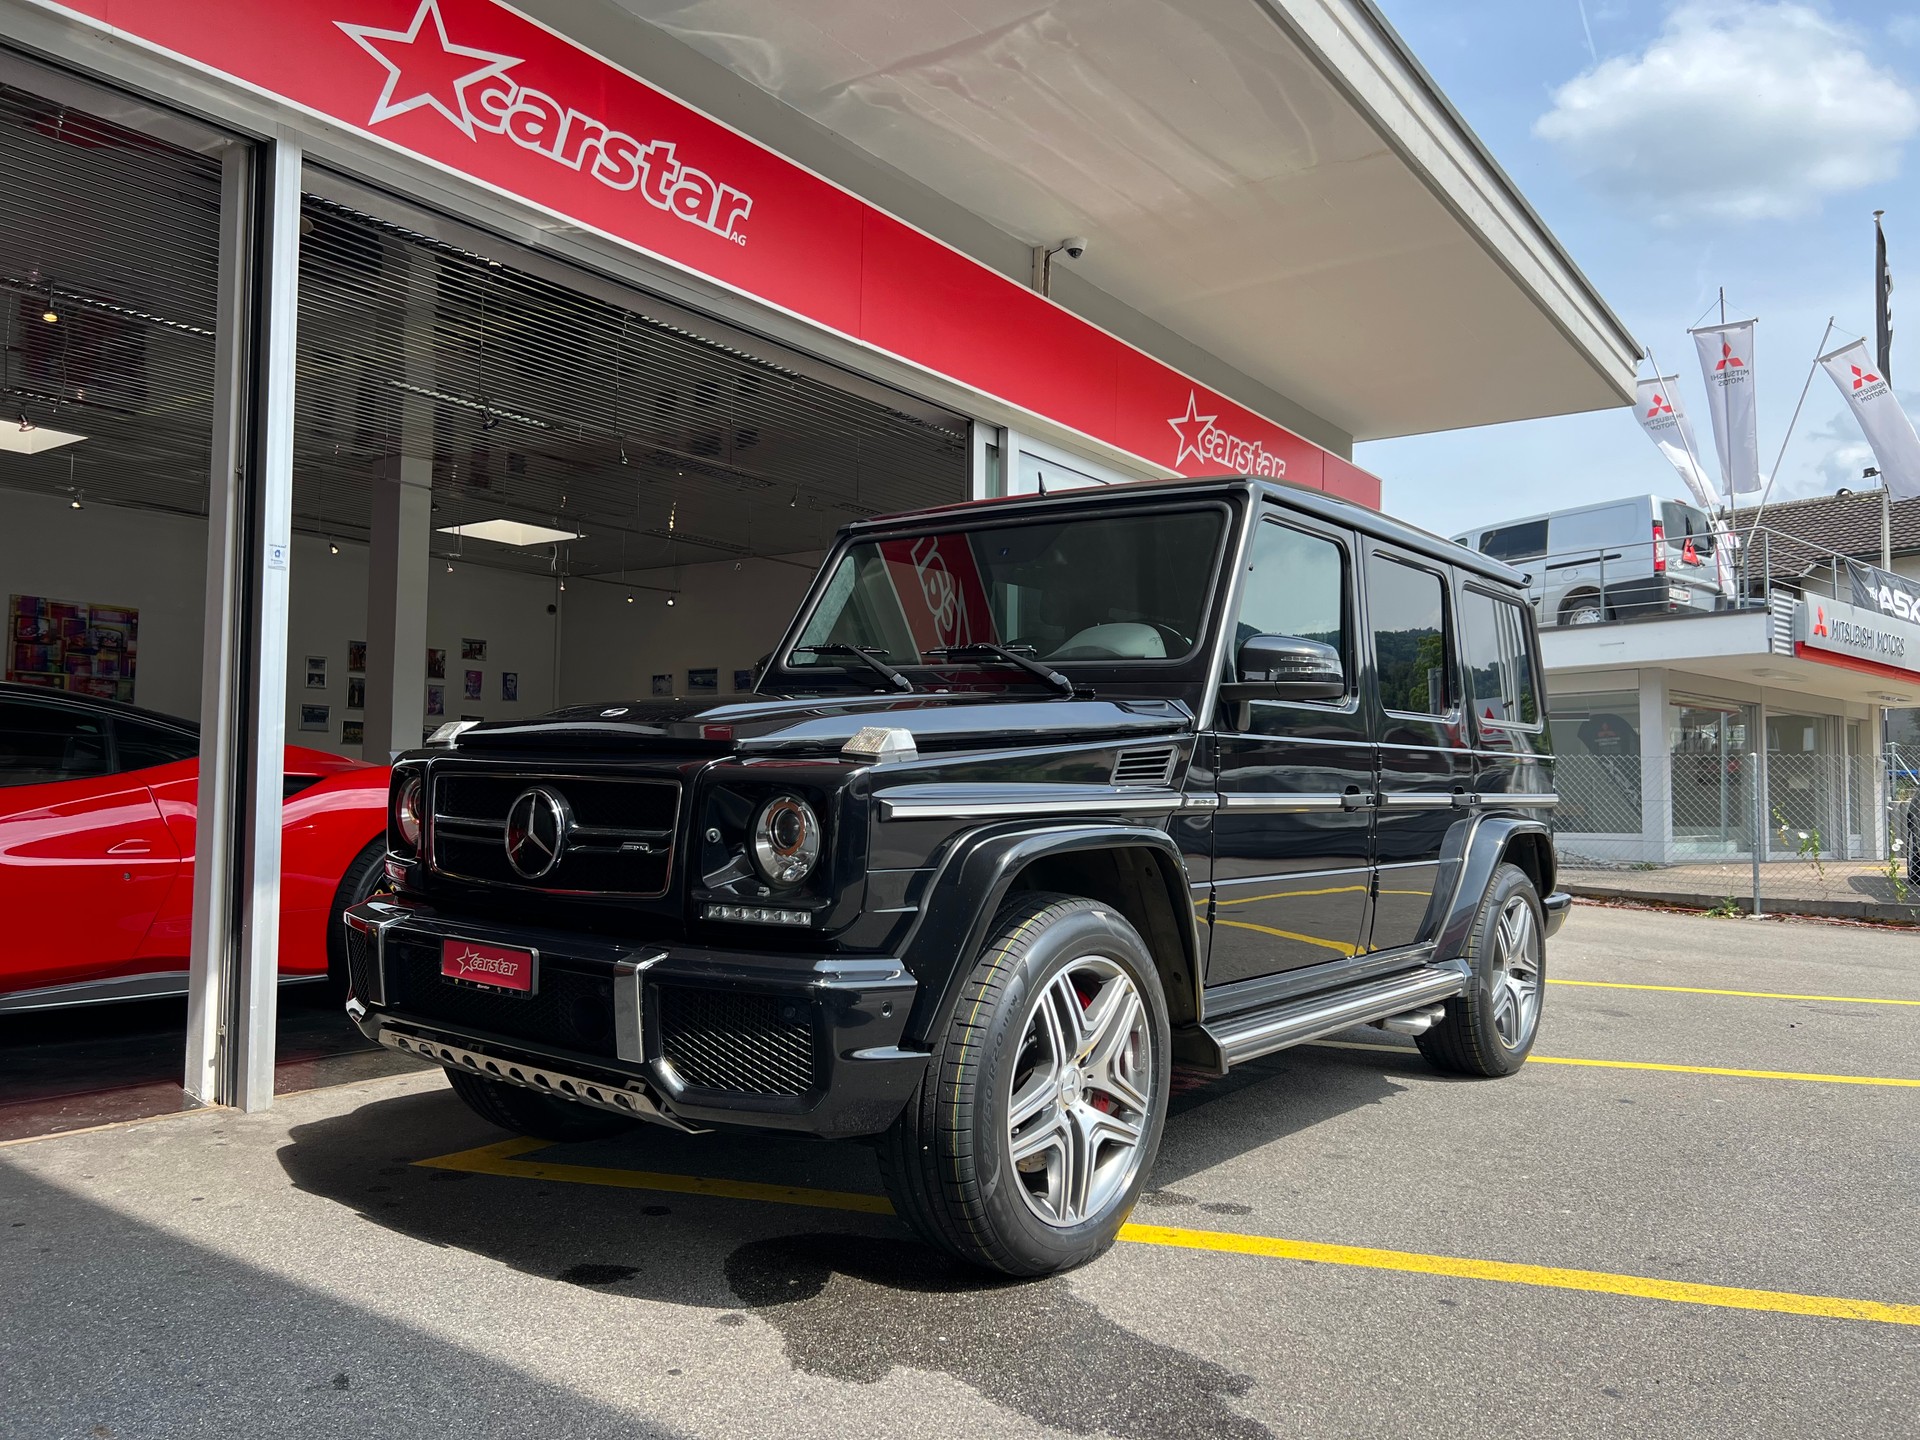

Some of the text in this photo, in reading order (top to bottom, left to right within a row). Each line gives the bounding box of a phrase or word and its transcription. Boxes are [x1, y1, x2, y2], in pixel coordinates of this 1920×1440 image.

[455, 72, 753, 247] carstar AG
[1852, 381, 1886, 399] MITSUBISH
[1860, 387, 1887, 403] MOTORS
[1643, 413, 1683, 426] MITSUBIHI
[1831, 619, 1904, 656] MITSUBISHI MOTORS
[470, 957, 518, 976] carstar
[988, 1032, 1003, 1081] R20
